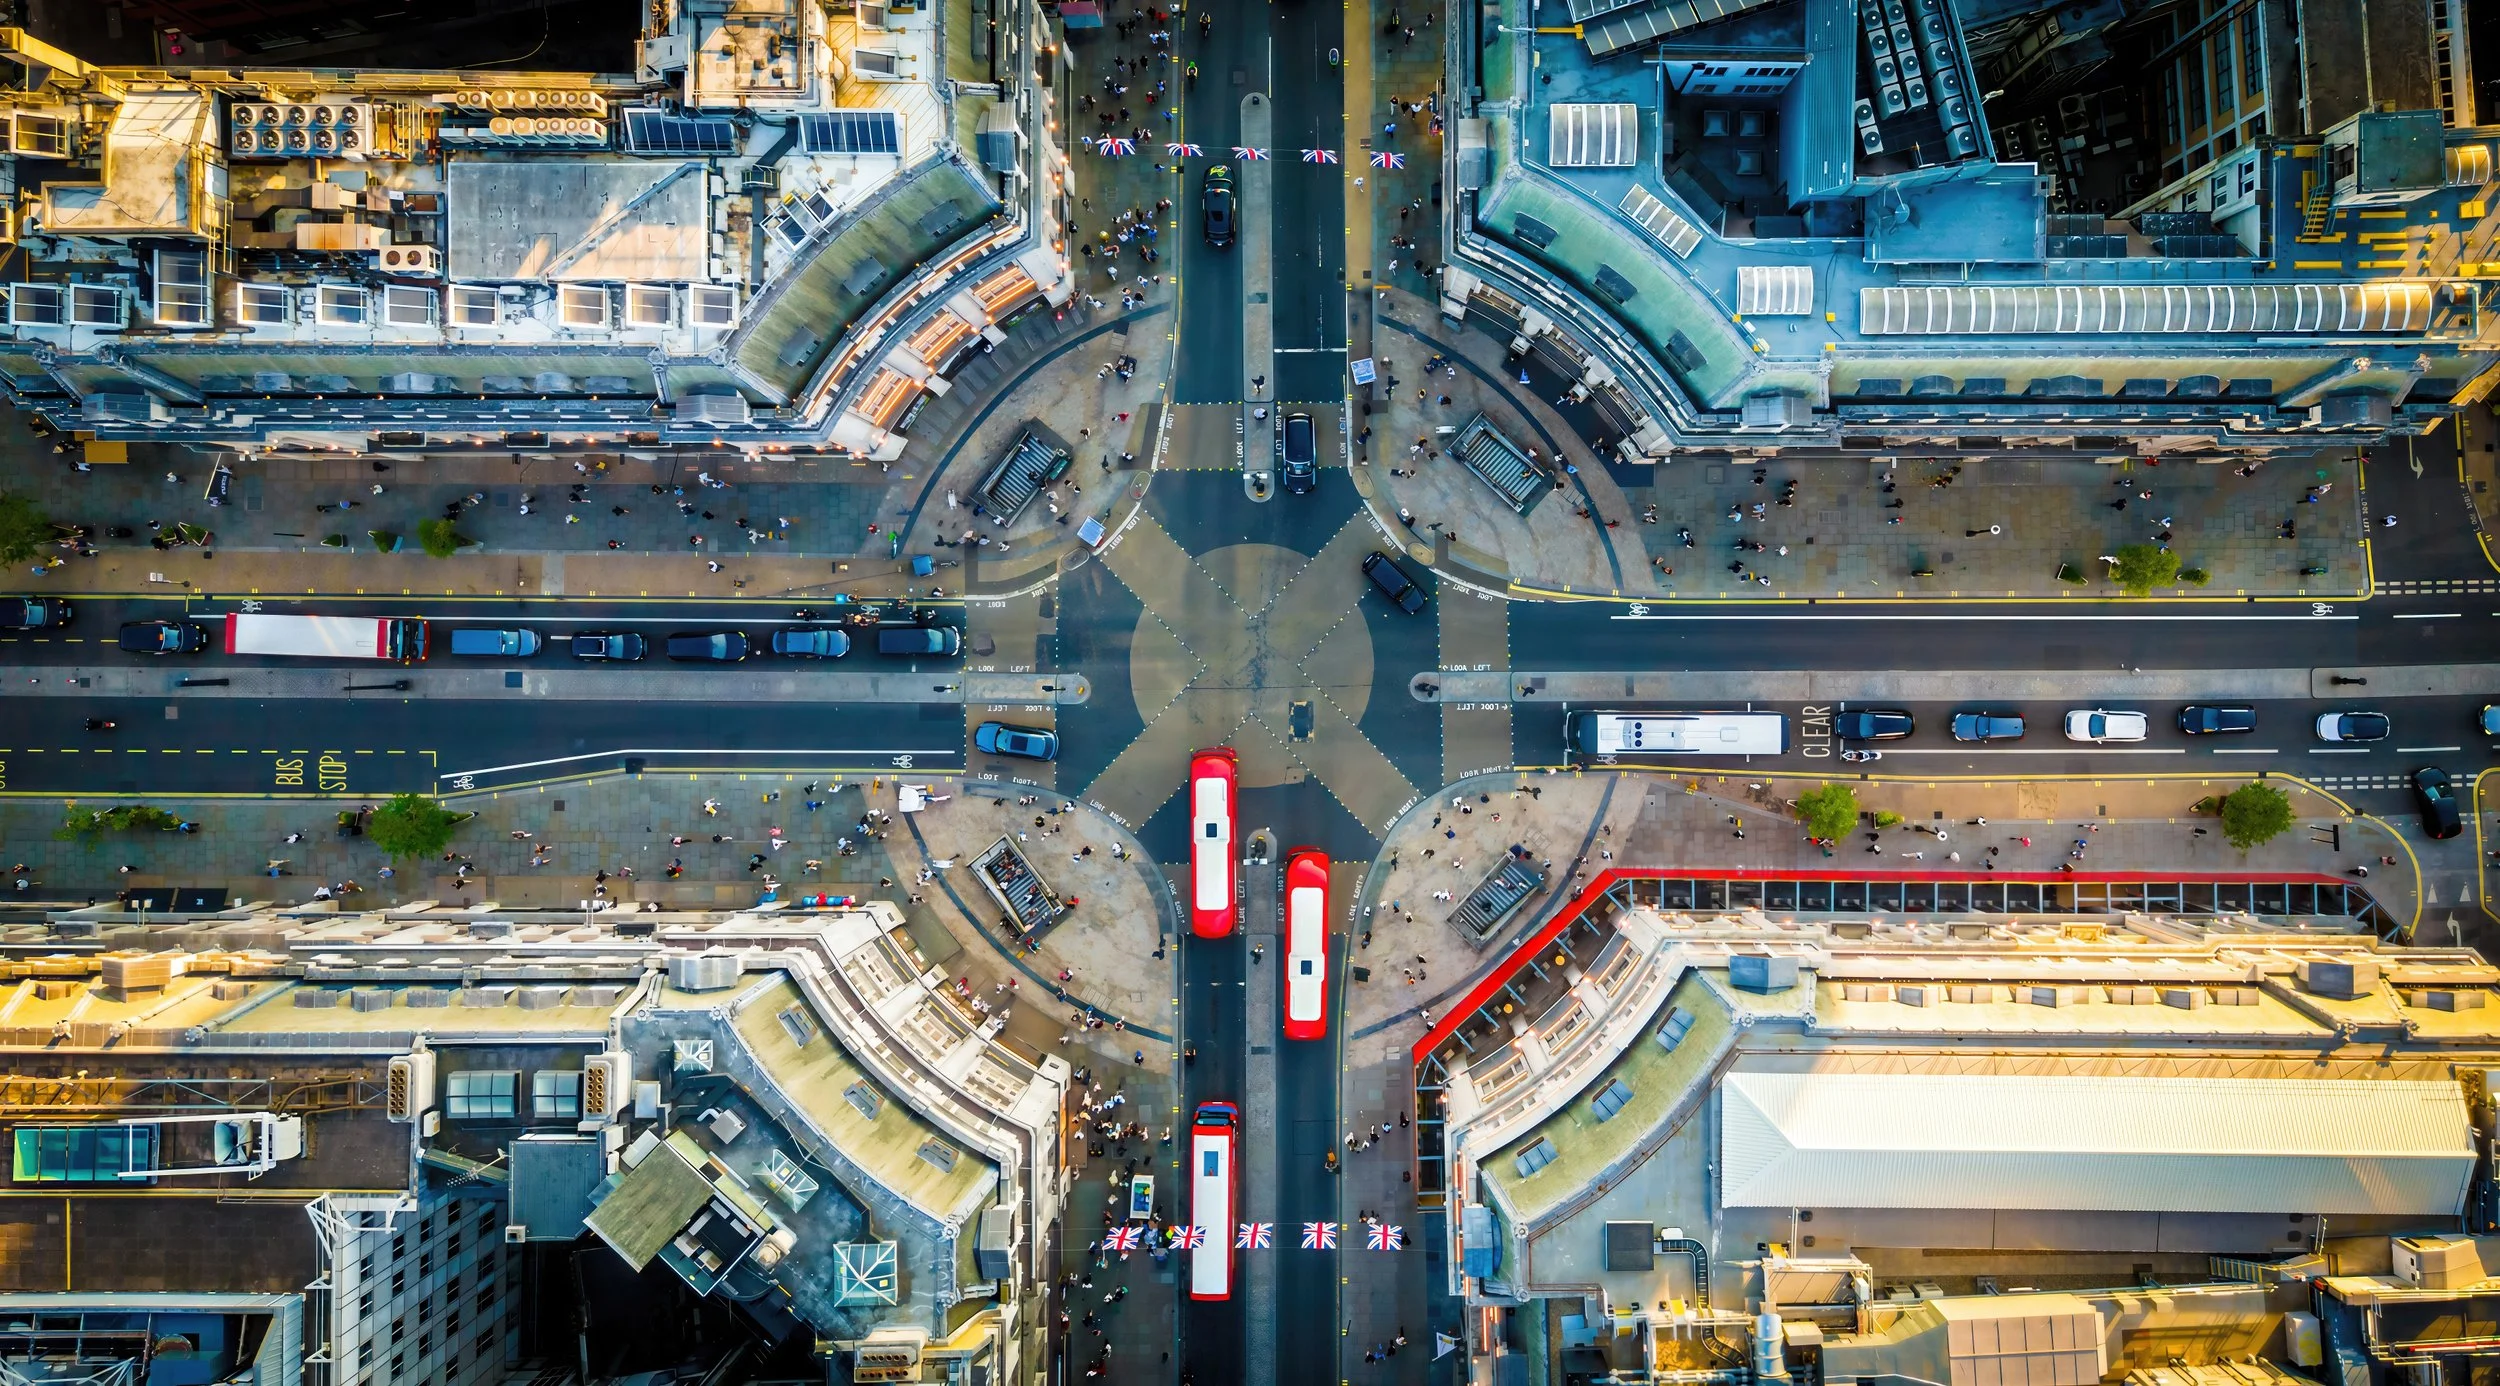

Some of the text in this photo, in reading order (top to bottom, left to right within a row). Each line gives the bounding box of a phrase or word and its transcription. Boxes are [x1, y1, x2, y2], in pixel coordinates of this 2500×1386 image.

[1802, 706, 1831, 758] CLEAR
[275, 758, 304, 785] BUS
[319, 755, 347, 791] STOP
